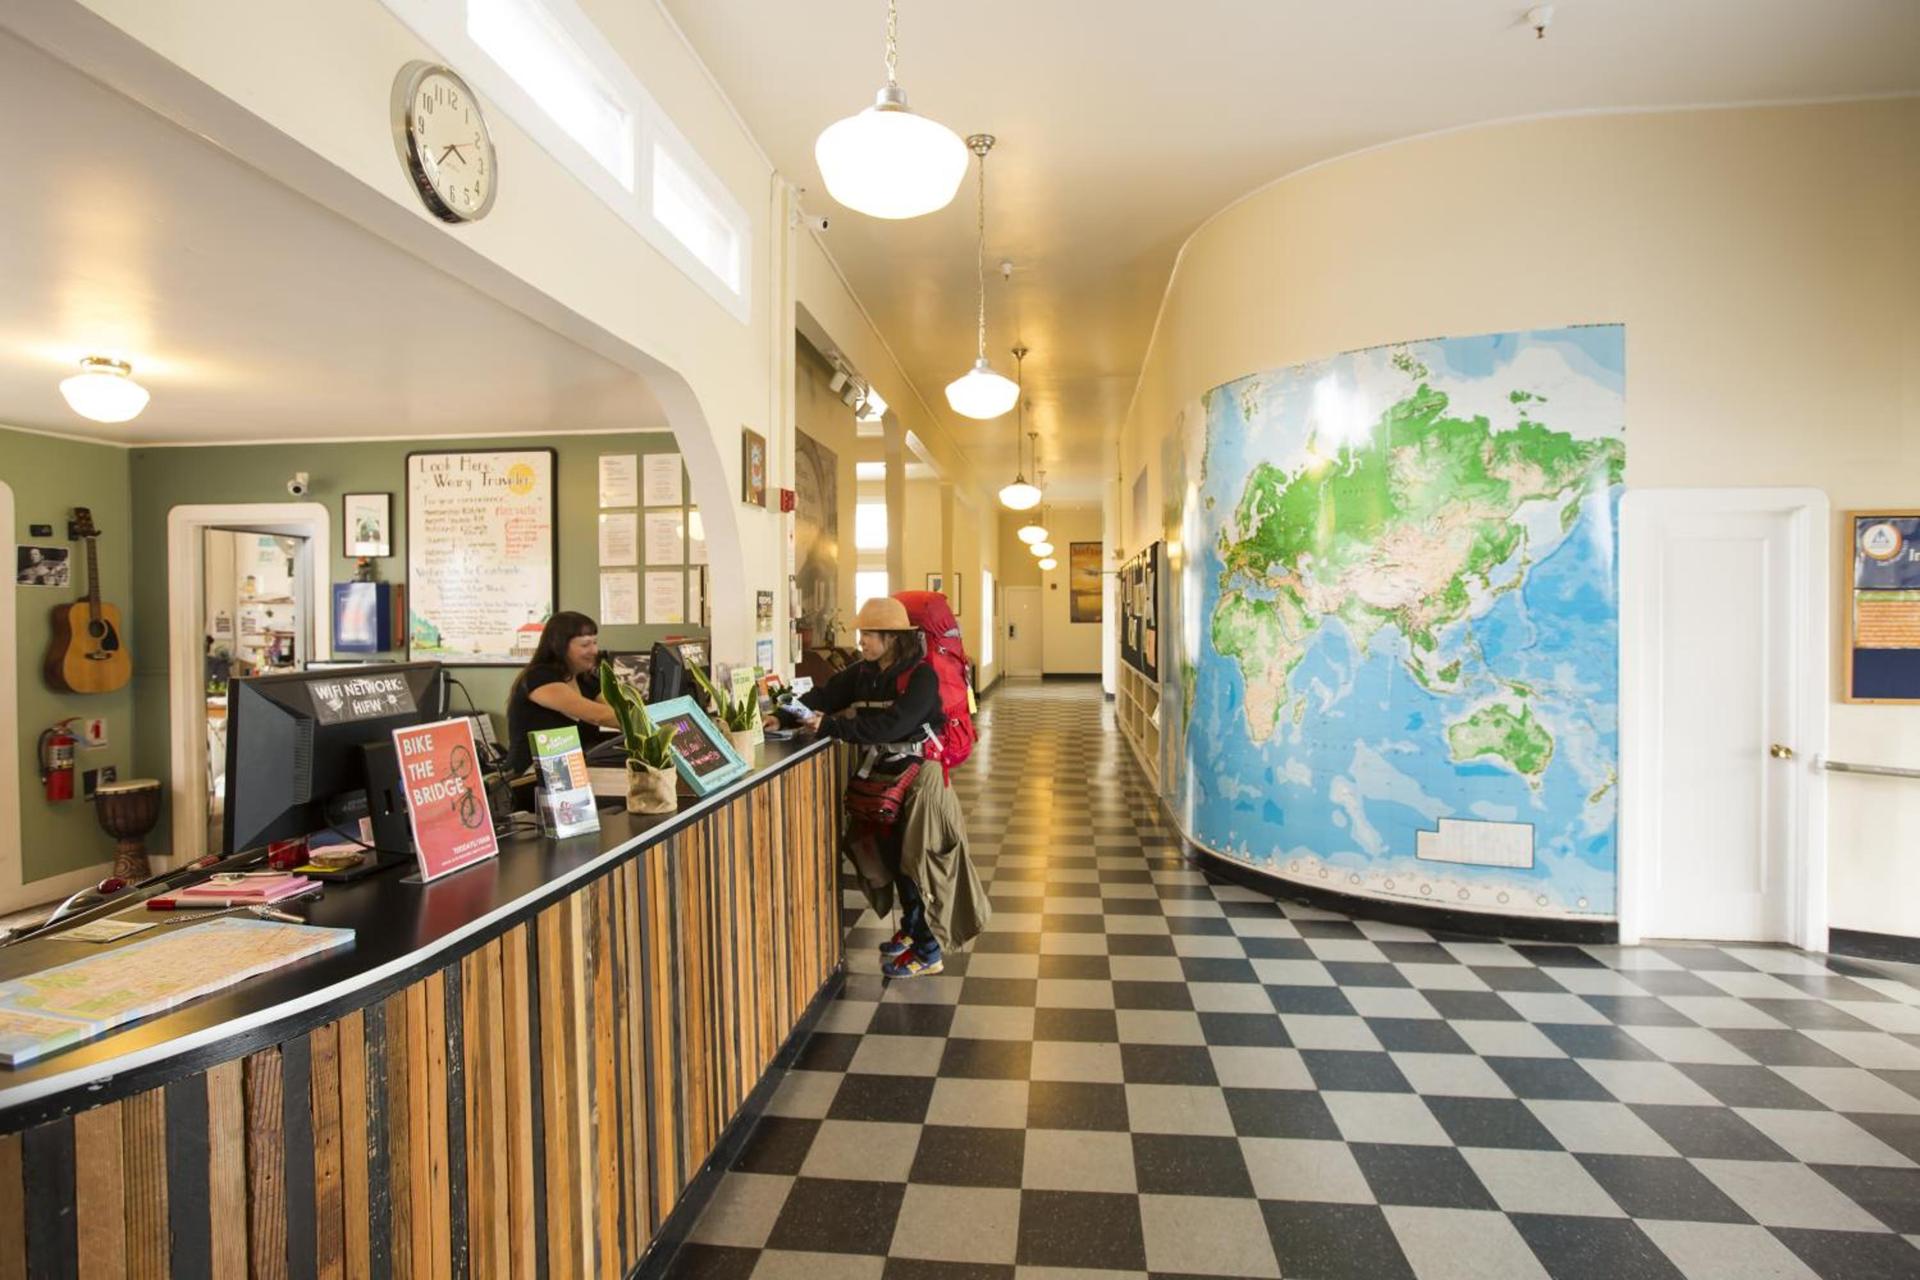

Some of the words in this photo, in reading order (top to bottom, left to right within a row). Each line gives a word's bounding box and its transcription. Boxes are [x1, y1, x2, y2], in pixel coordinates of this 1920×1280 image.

[422, 92, 434, 115] 10
[434, 84, 443, 106] 11
[448, 88, 458, 111] 12
[418, 115, 425, 135] 9
[474, 132, 481, 149] 2
[478, 158, 484, 175] 3
[450, 185, 456, 204] 6
[464, 188, 470, 205] 5
[473, 180, 480, 196] 4
[315, 684, 344, 700] WIFI
[352, 698, 382, 715] HIFW
[403, 734, 434, 756] BIKE
[408, 760, 435, 782] THE
[413, 777, 465, 806] BRIDGE
